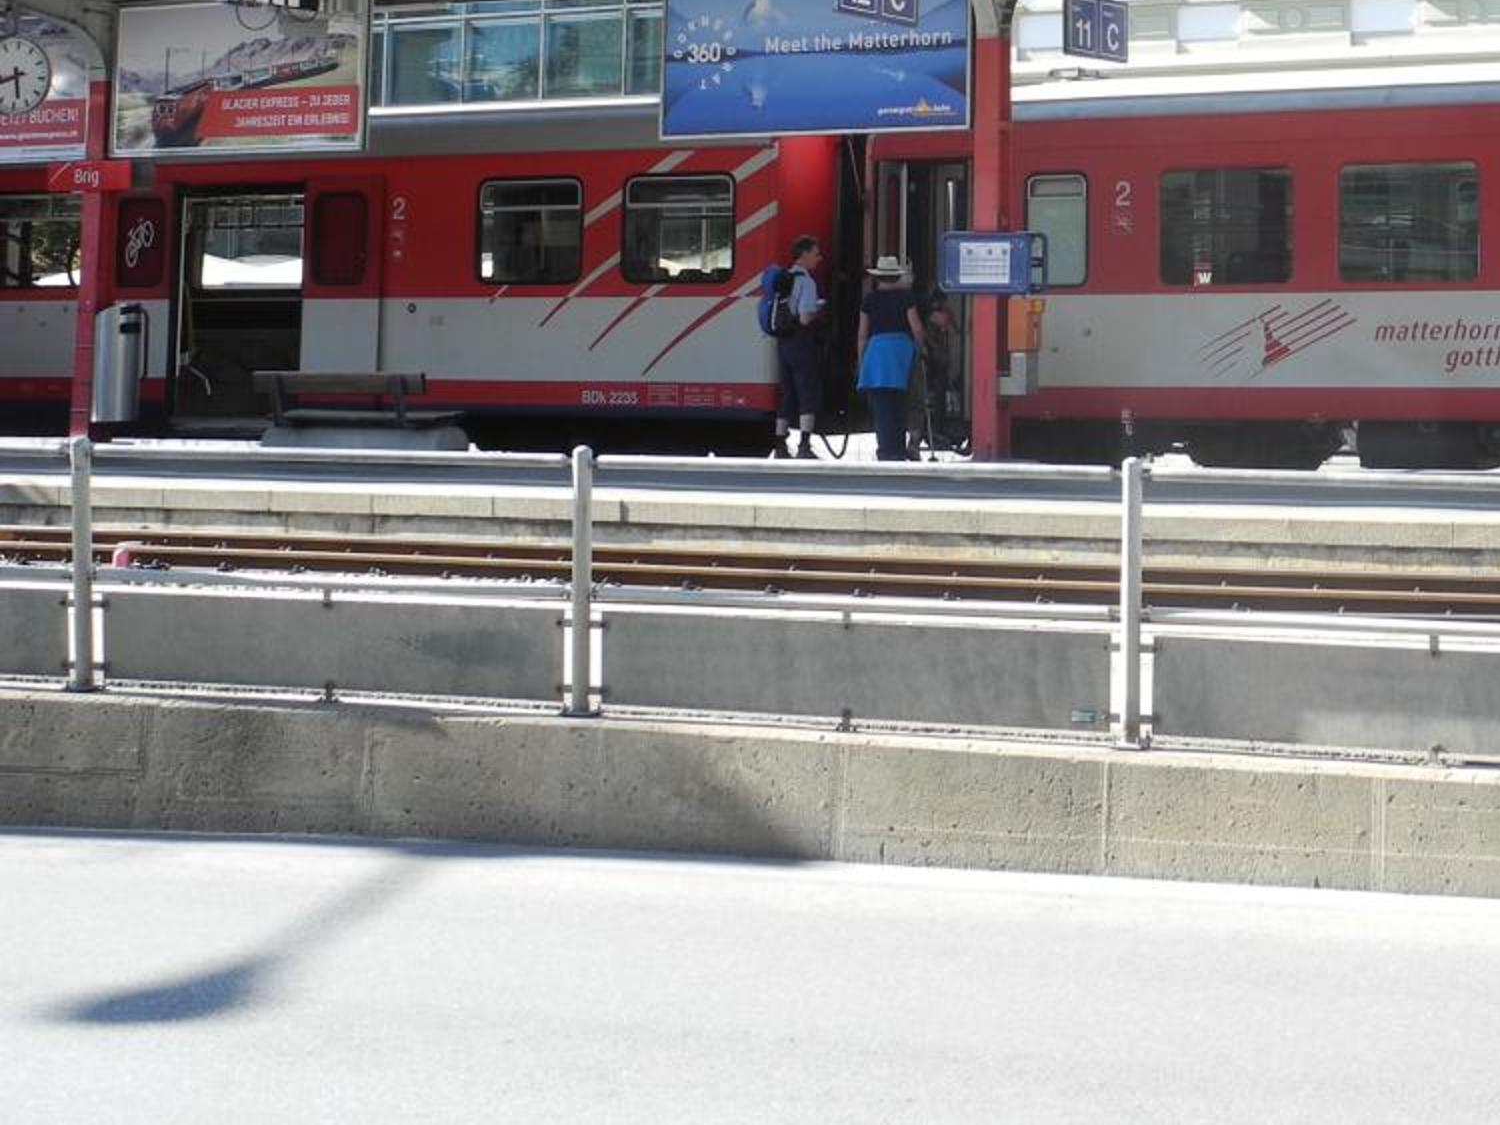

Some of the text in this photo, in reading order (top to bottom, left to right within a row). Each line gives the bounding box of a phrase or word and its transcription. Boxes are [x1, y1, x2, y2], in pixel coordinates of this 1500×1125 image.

[765, 29, 952, 54] Meet the Matterhorn
[1075, 18, 1092, 49] 11
[1107, 23, 1119, 52] C
[687, 42, 720, 64] 360
[74, 168, 99, 187] Brig
[1115, 180, 1131, 206] 2
[393, 196, 406, 220] 2
